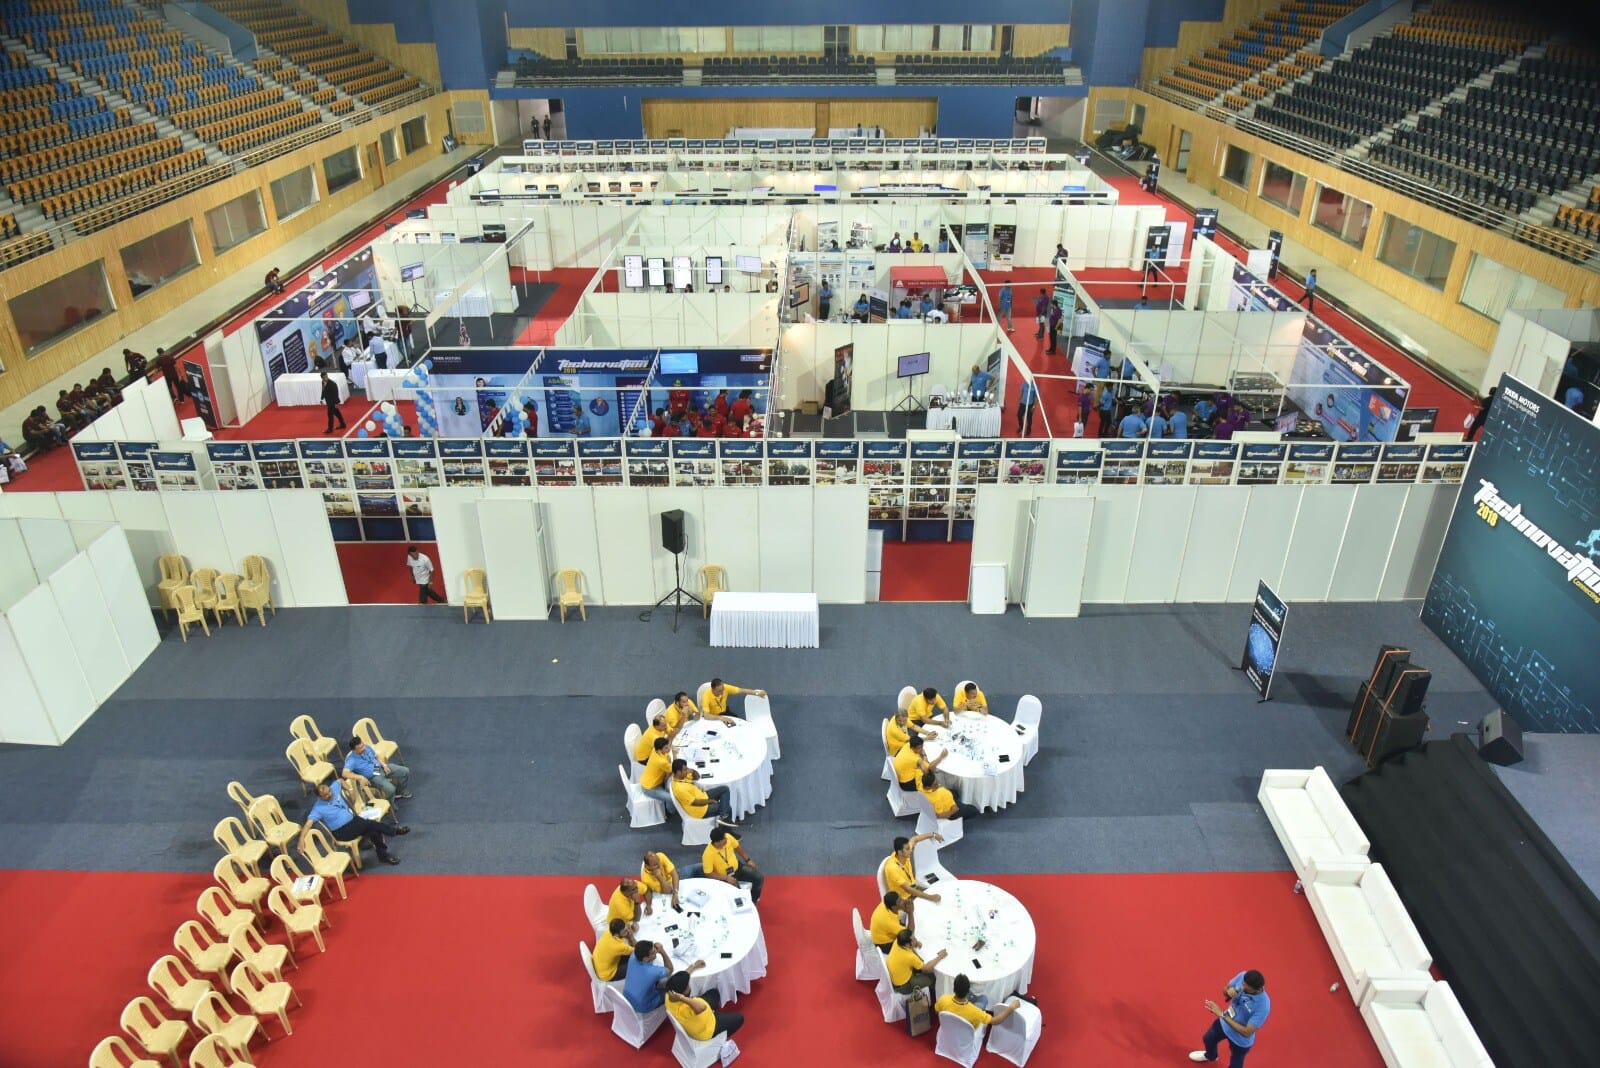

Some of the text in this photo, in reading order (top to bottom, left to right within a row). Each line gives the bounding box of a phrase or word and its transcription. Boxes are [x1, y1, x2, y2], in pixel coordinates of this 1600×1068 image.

[1504, 387, 1518, 401] TATA
[1518, 395, 1540, 413] MOTORS
[1476, 502, 1498, 527] 2018
[1474, 478, 1600, 598] Technovatio
